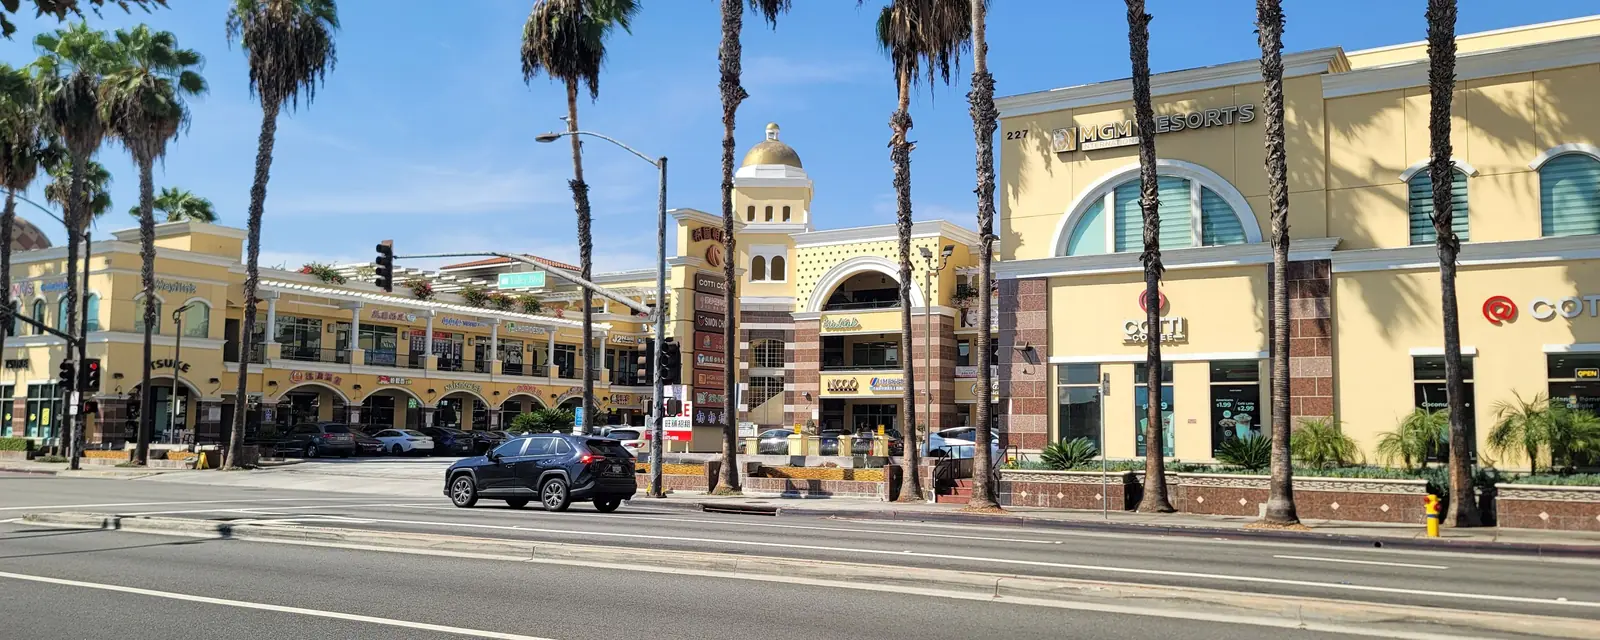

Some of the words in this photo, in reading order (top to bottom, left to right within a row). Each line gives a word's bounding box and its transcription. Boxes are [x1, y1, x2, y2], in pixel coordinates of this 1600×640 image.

[1080, 119, 1132, 142] MGM
[1152, 103, 1256, 134] ESORTS
[1007, 129, 1029, 140] 227
[1083, 136, 1140, 150] INTERNATIONA
[699, 279, 716, 288] COTTI
[1132, 333, 1174, 341] COEE
[1577, 370, 1598, 378] OPEN
